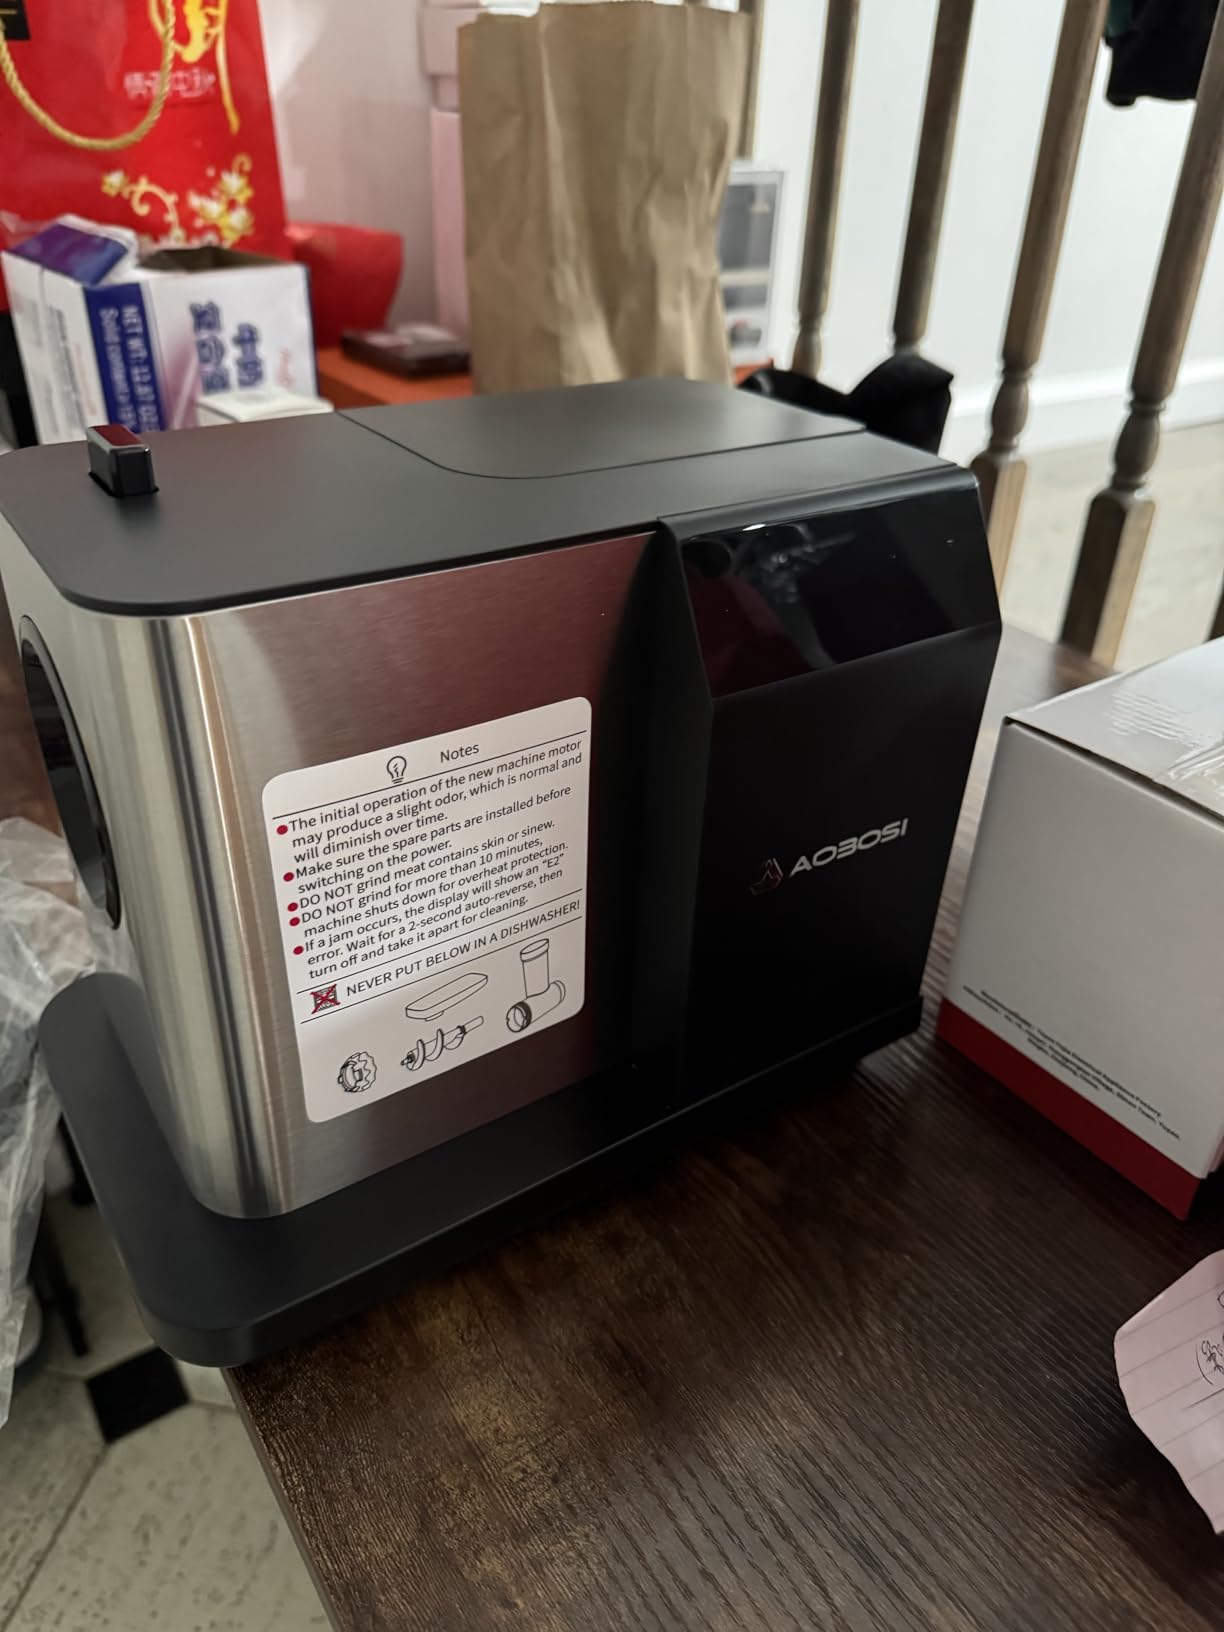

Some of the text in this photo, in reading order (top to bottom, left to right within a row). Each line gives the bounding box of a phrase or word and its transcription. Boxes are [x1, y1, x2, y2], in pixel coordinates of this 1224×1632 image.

[288, 739, 582, 833] The initial operation of the new machine motor
[440, 743, 480, 763] Notes
[291, 751, 583, 849] may produce a slight odor, which is normal and
[293, 812, 448, 864] will diminish over time.
[295, 786, 572, 880] Make sure the spare parts are installed before
[297, 839, 453, 895] switching on the power.
[299, 820, 555, 910] DO NOT grind meat contains skin or sinew.
[301, 838, 544, 924] DO NOT grind for more than 10 minutes,
[303, 842, 569, 938] machine shuts down for overheat protection.
[788, 817, 909, 878] AOBOSI
[304, 938, 315, 953] If
[317, 938, 326, 949] a
[327, 929, 354, 948] jam
[356, 914, 403, 936] occurs,
[404, 905, 426, 920] the
[426, 889, 470, 911] display
[471, 879, 492, 896] will
[493, 870, 524, 888] show
[525, 865, 539, 877] an
[307, 869, 563, 966] error. Wait for a 2-second auto-reverse, then
[308, 895, 529, 980] turn off and take it apart for cleaning.
[346, 899, 580, 997] NEVER PUT BELOW IN A DISHWASHER!
